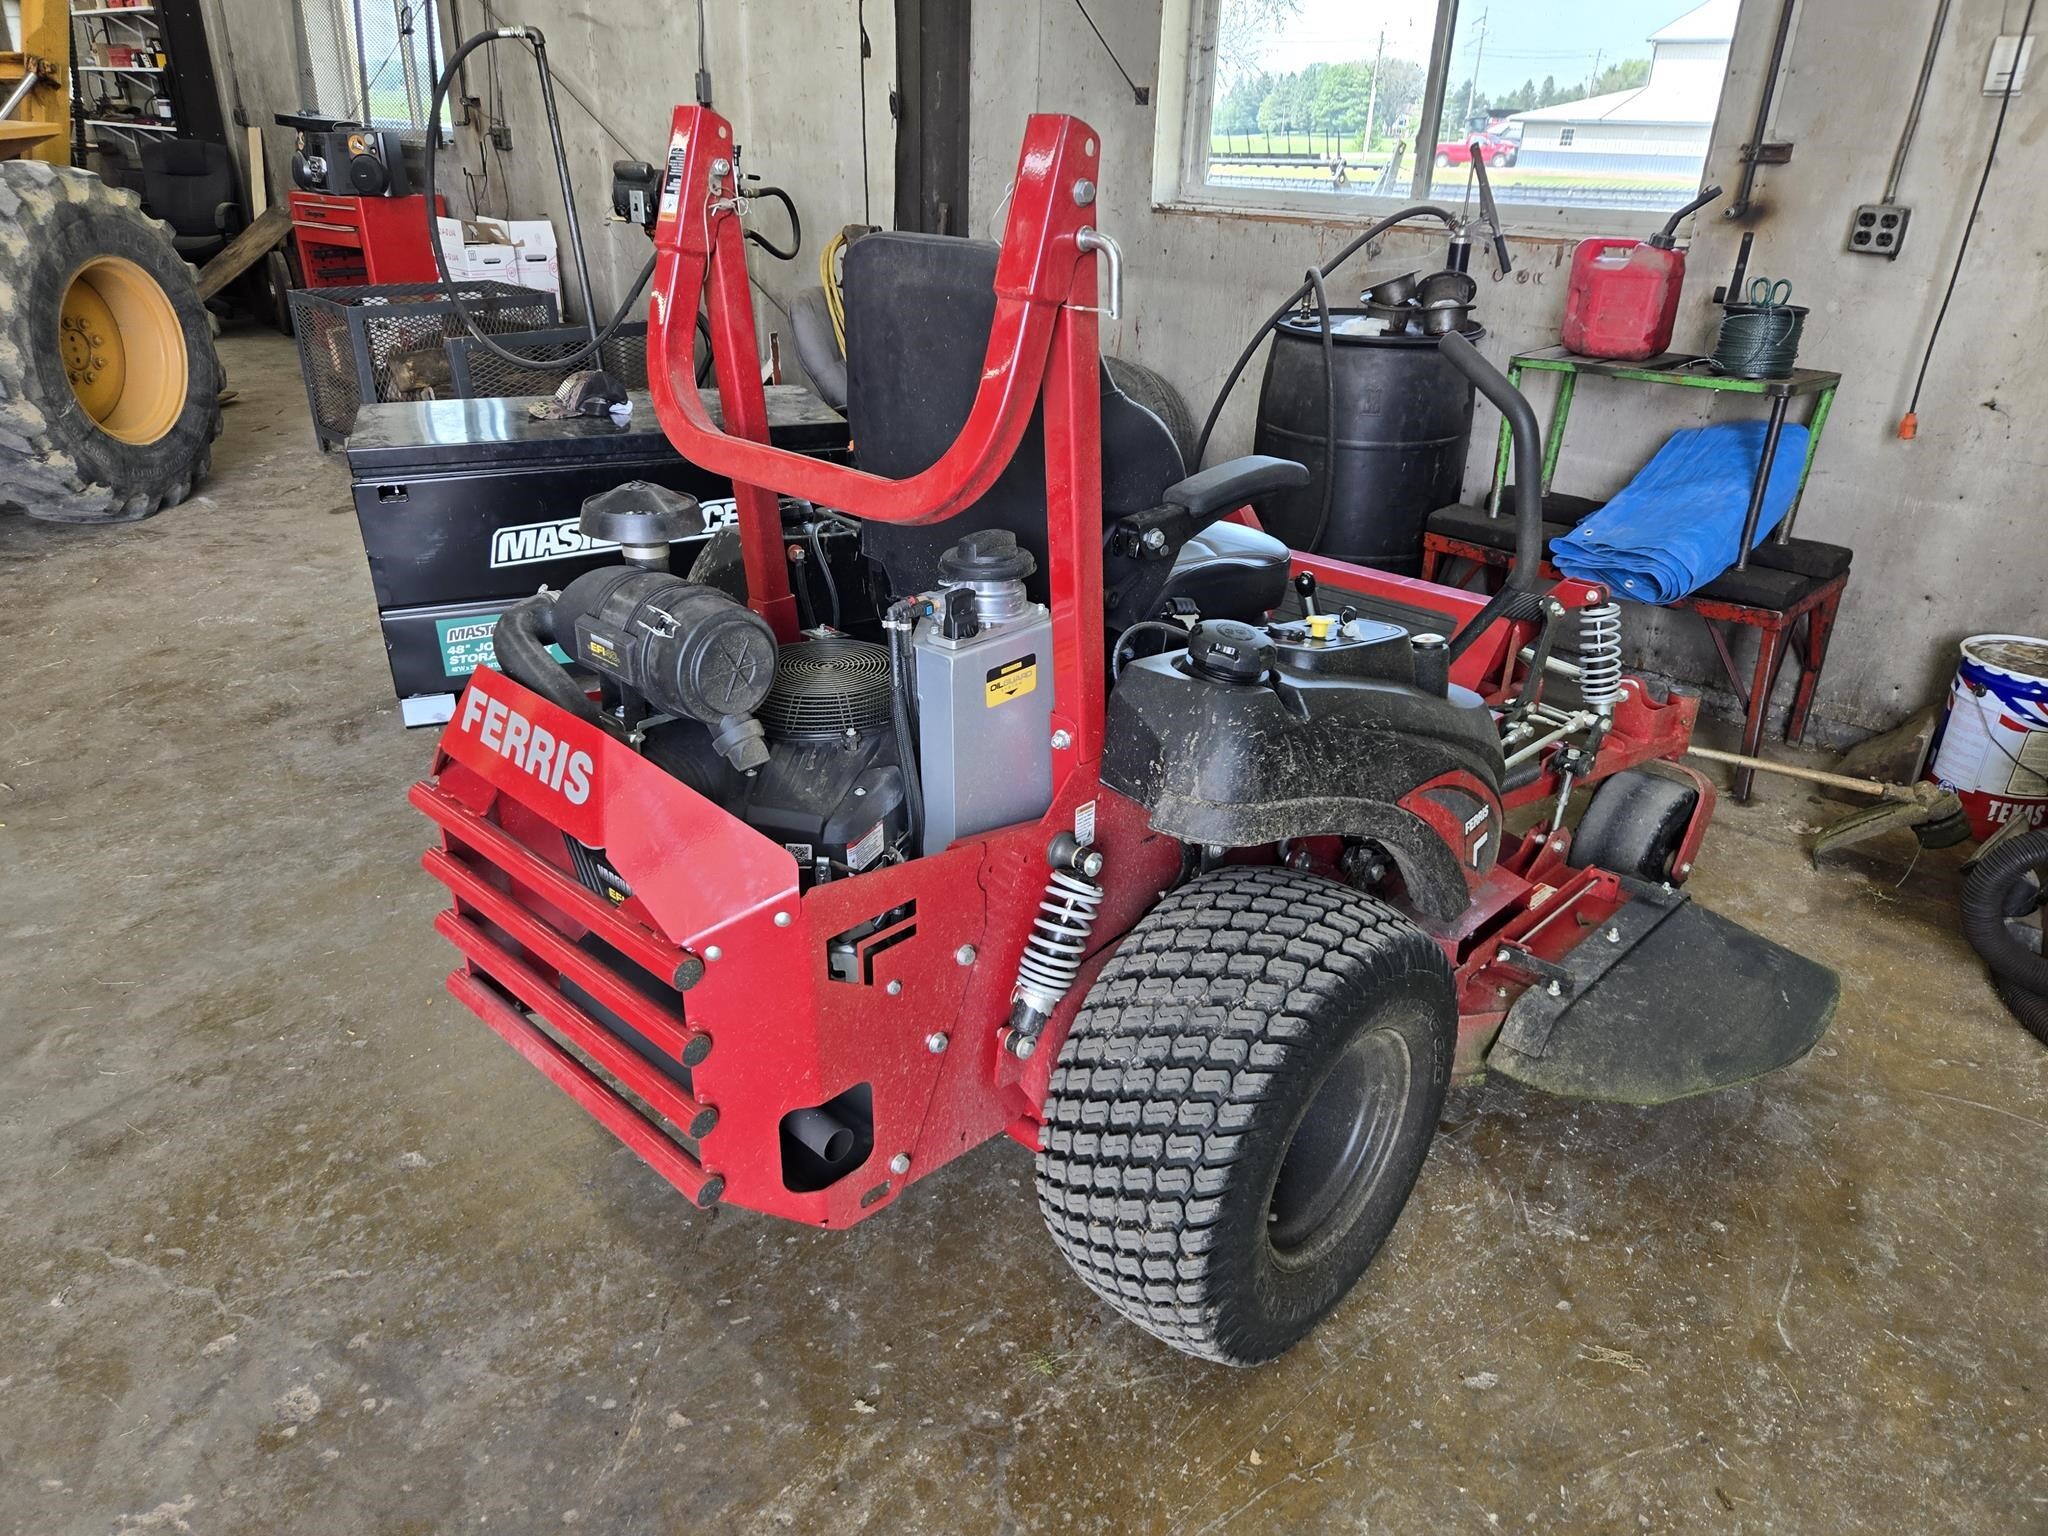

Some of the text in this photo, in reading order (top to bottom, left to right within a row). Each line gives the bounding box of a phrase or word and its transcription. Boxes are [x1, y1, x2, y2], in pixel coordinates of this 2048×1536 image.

[447, 643, 471, 655] 48"
[449, 651, 497, 665] STORA
[461, 685, 594, 806] FERRIS
[1465, 804, 1489, 836] FERRIS
[1987, 800, 2046, 826] TEXAS
